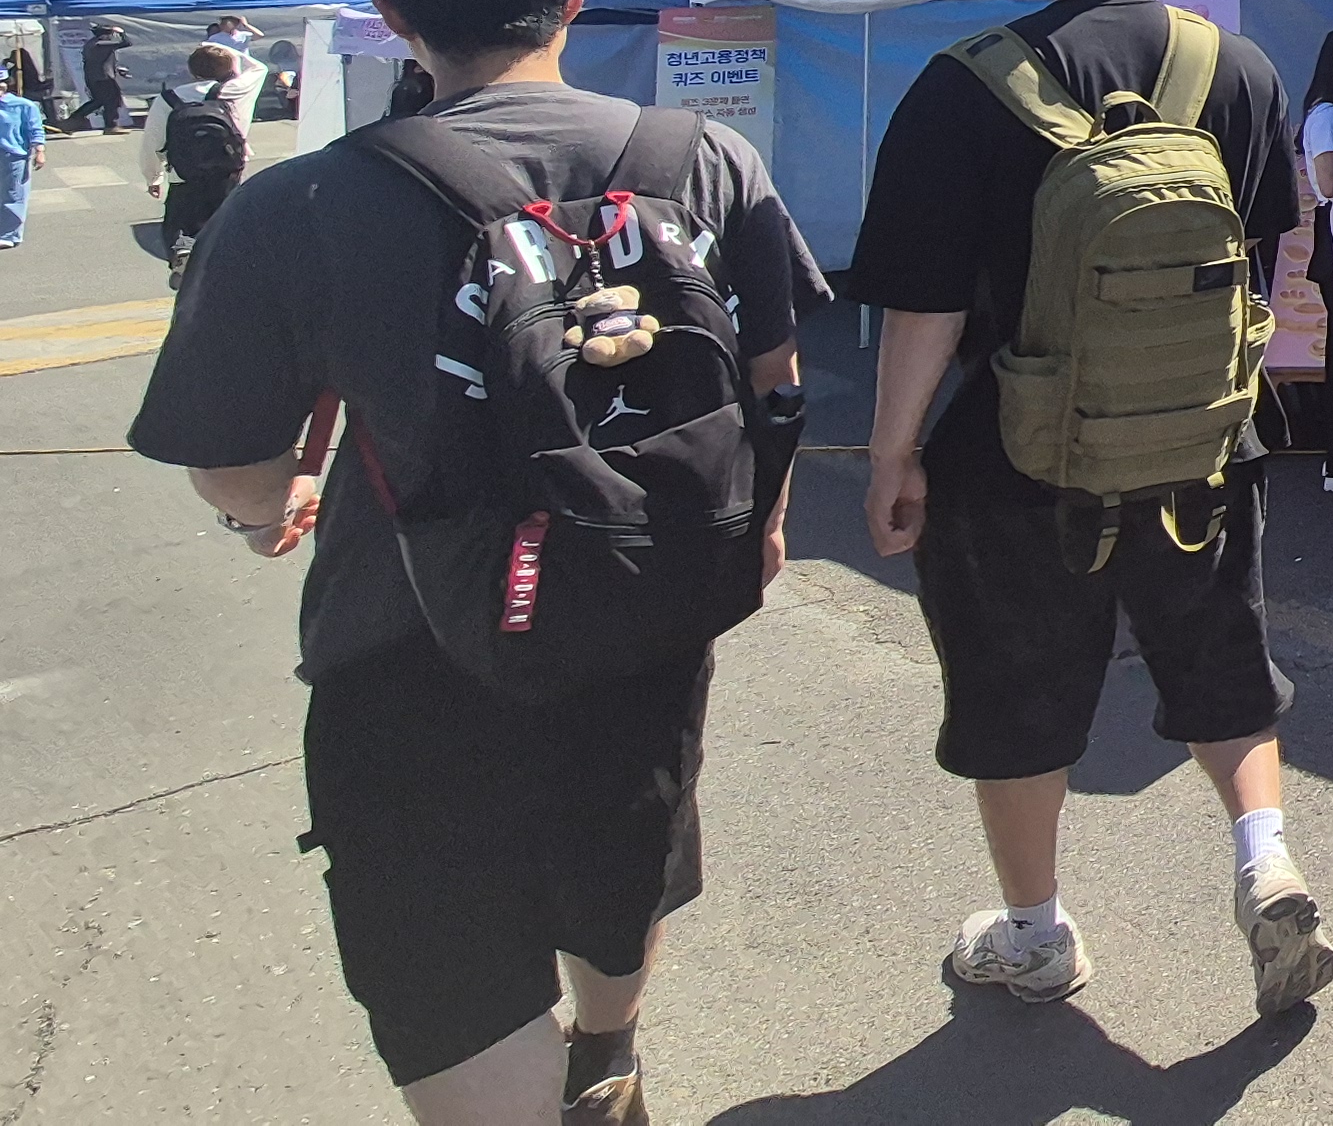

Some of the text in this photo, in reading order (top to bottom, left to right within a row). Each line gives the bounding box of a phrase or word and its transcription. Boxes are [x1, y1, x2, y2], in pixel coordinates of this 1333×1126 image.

[665, 48, 766, 66] 청년고용정책
[672, 68, 759, 87] 퀴즈 이벤트
